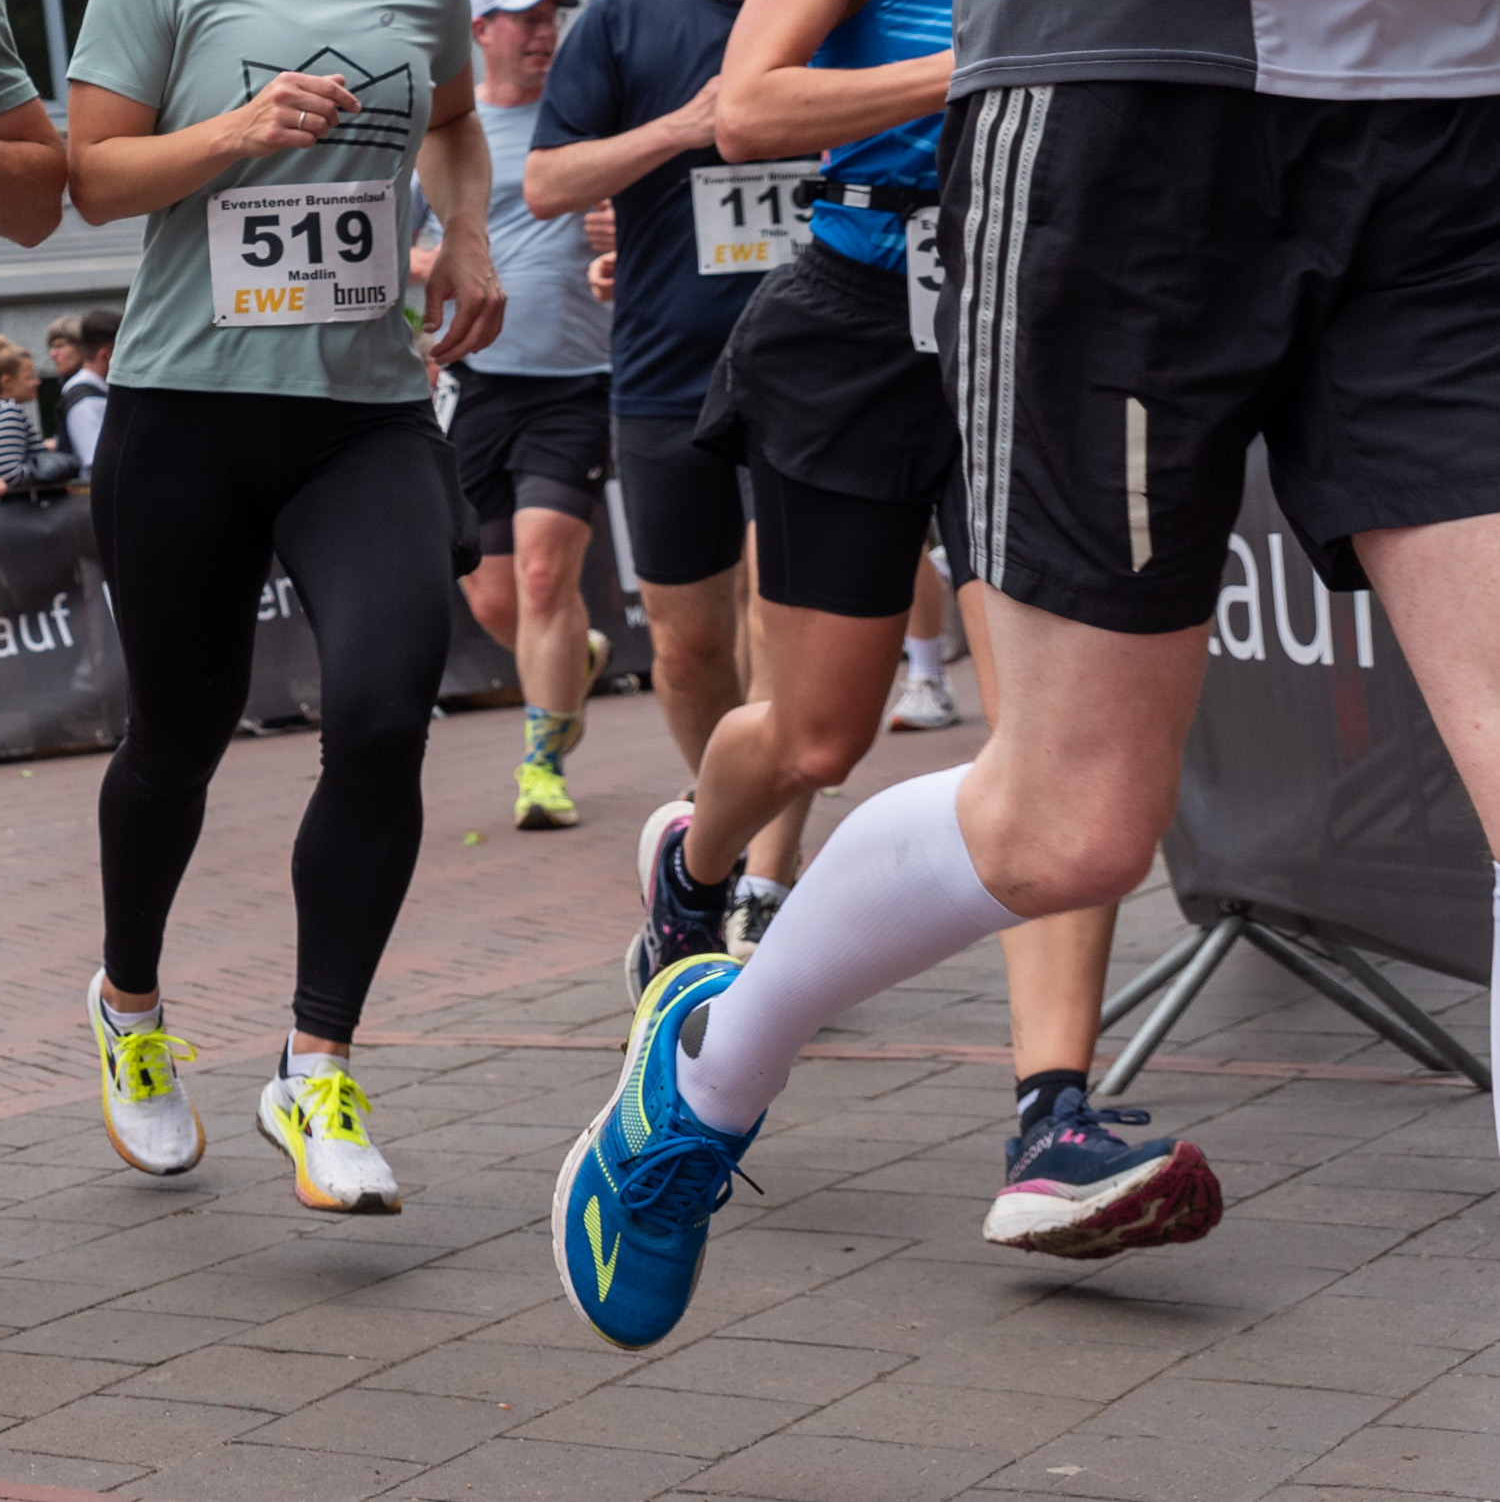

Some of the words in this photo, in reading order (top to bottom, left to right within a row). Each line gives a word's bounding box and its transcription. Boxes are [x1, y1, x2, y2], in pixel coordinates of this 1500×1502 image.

[221, 198, 300, 210] Everstener
[305, 191, 386, 206] Brunnenlauf
[241, 210, 373, 268] 519
[714, 242, 769, 264] EWE
[288, 269, 336, 281] Madlin
[234, 286, 305, 314] EWE
[334, 282, 386, 305] bruns
